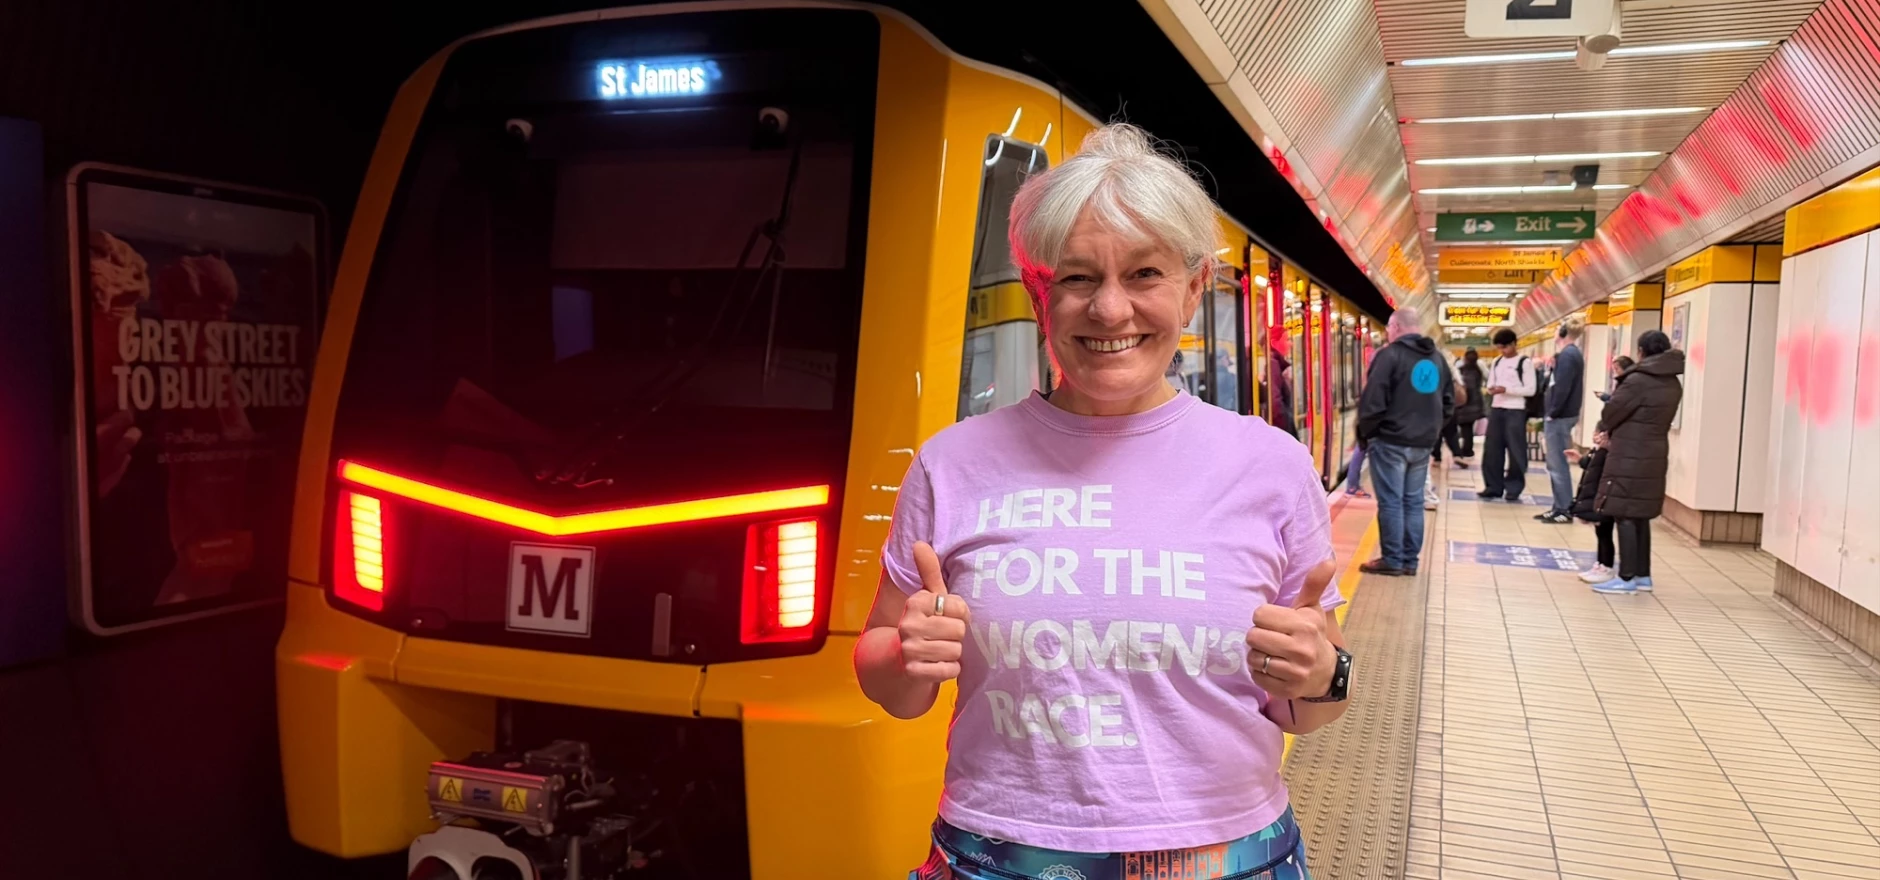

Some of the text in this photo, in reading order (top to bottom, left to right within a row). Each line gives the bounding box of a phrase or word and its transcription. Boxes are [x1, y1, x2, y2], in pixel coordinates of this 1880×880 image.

[600, 63, 705, 97] St James
[1515, 216, 1551, 232] Exit
[118, 316, 300, 364] GREY STREET
[112, 364, 306, 411] TO BLUE SKIES
[974, 484, 1113, 534] HERE
[518, 554, 582, 621] M
[971, 548, 1206, 600] FOR THE
[970, 618, 1246, 676] WOMEN'S
[984, 690, 1138, 748] RACE.
